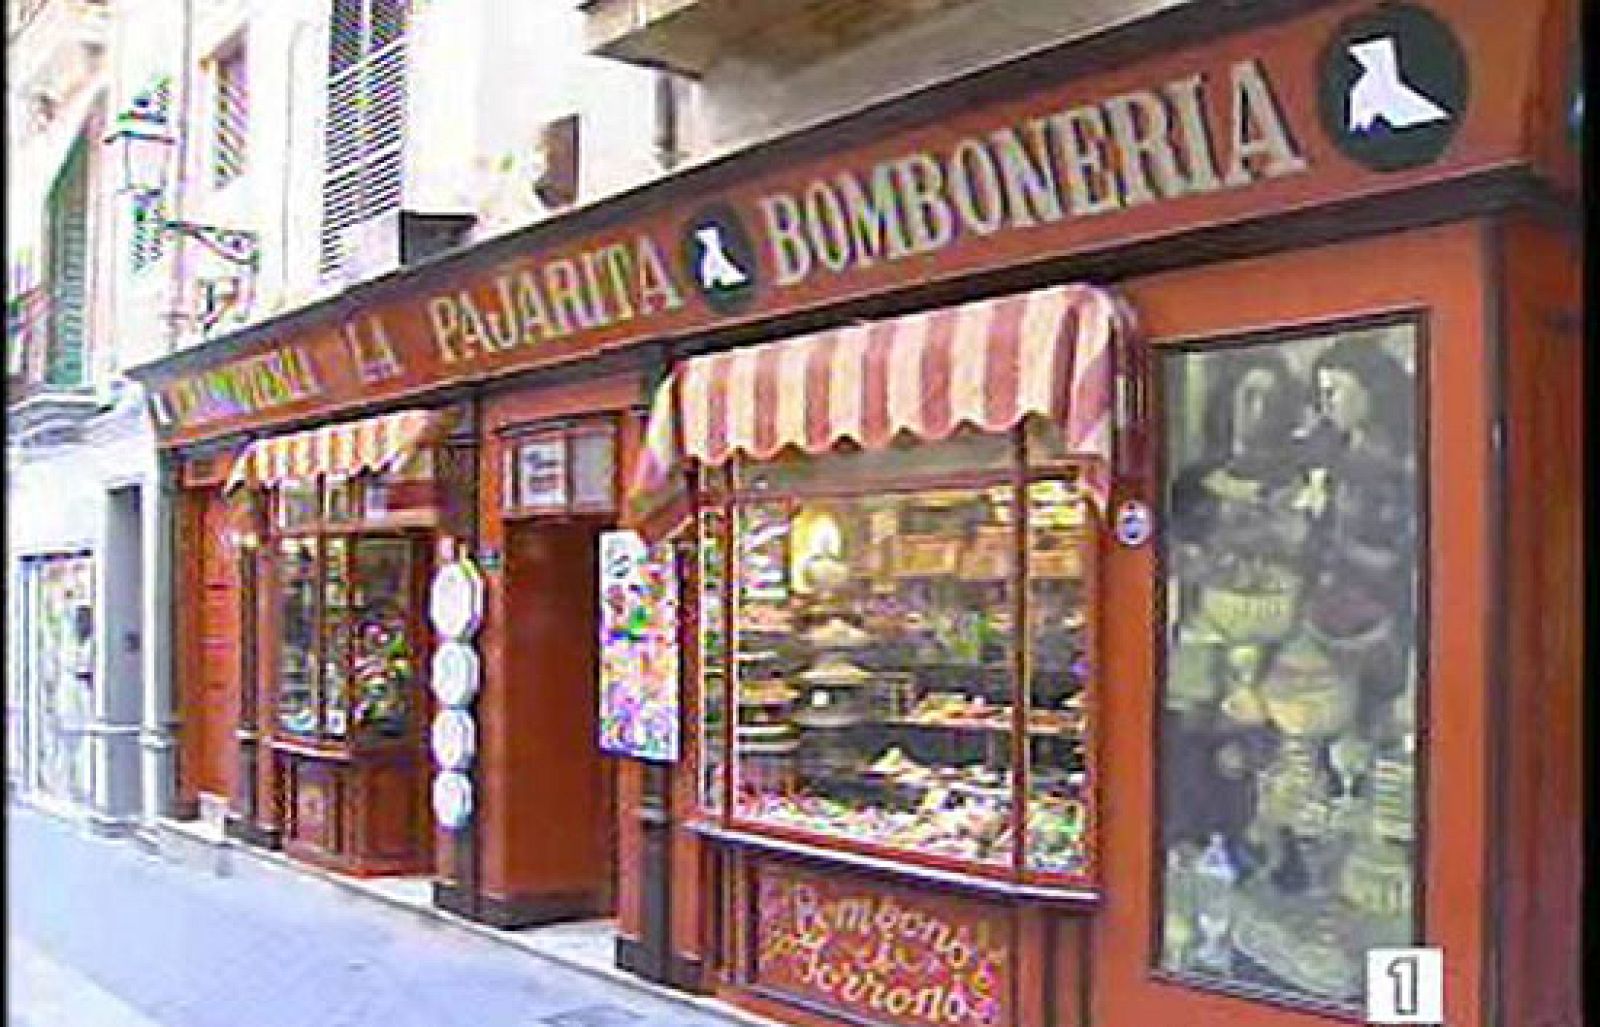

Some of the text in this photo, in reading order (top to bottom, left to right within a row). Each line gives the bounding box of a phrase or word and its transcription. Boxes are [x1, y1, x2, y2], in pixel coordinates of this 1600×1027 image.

[343, 318, 405, 383] LA
[429, 236, 685, 362] PAJARITA
[762, 60, 1308, 285] BOMBONERIA
